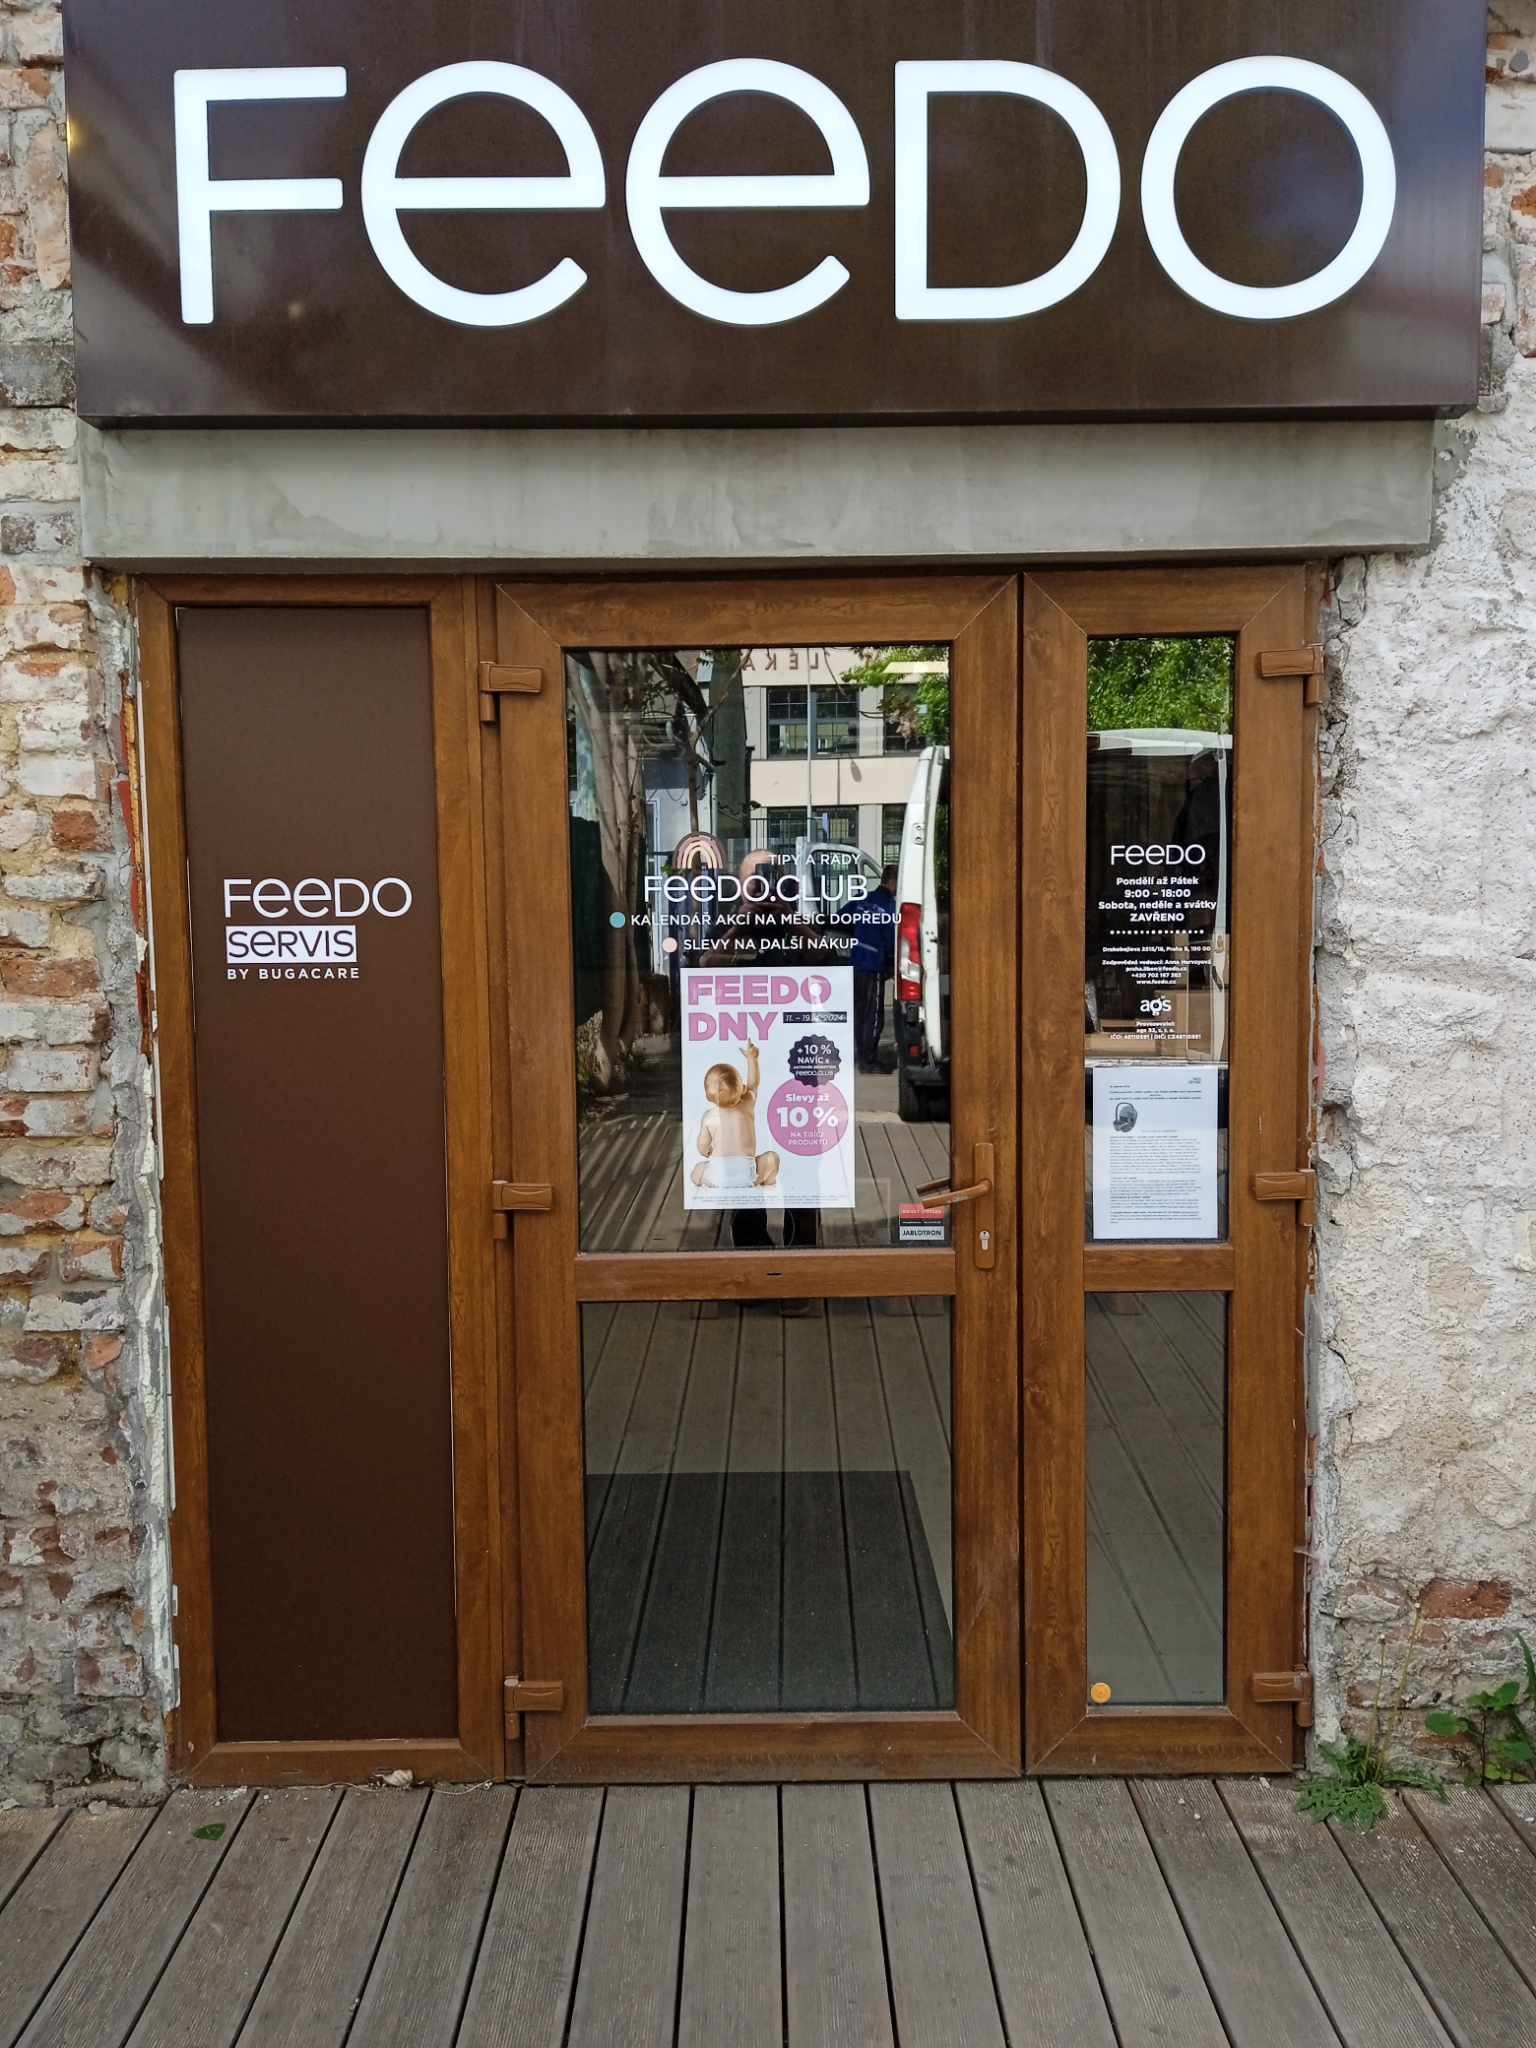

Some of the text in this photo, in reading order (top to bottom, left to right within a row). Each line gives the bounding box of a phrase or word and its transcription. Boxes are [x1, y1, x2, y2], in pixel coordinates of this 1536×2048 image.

[769, 853, 861, 866] TIPY A RADY
[1116, 876, 1199, 885] Pondělí až Pátek
[1124, 889, 1150, 898] 9:00
[1161, 889, 1191, 898] 18:00
[1098, 901, 1137, 910] Sobota,
[1139, 901, 1173, 909] neděle
[1183, 900, 1216, 910] svátky
[630, 911, 902, 926] KALENDÁŘ AKCÍ NA MĚSÍC DOPŘEDU
[1130, 911, 1185, 922] ZAVŘENO
[683, 935, 859, 950] SLEVY NA DALŠÍ NÁKUP
[227, 967, 360, 980] BY BUGACARE
[687, 975, 832, 1006] FEEDO
[688, 1011, 779, 1042] DNY
[785, 1093, 815, 1103] Slevy
[776, 1106, 839, 1128] 10 %
[902, 1229, 942, 1237] JABLOTRON
